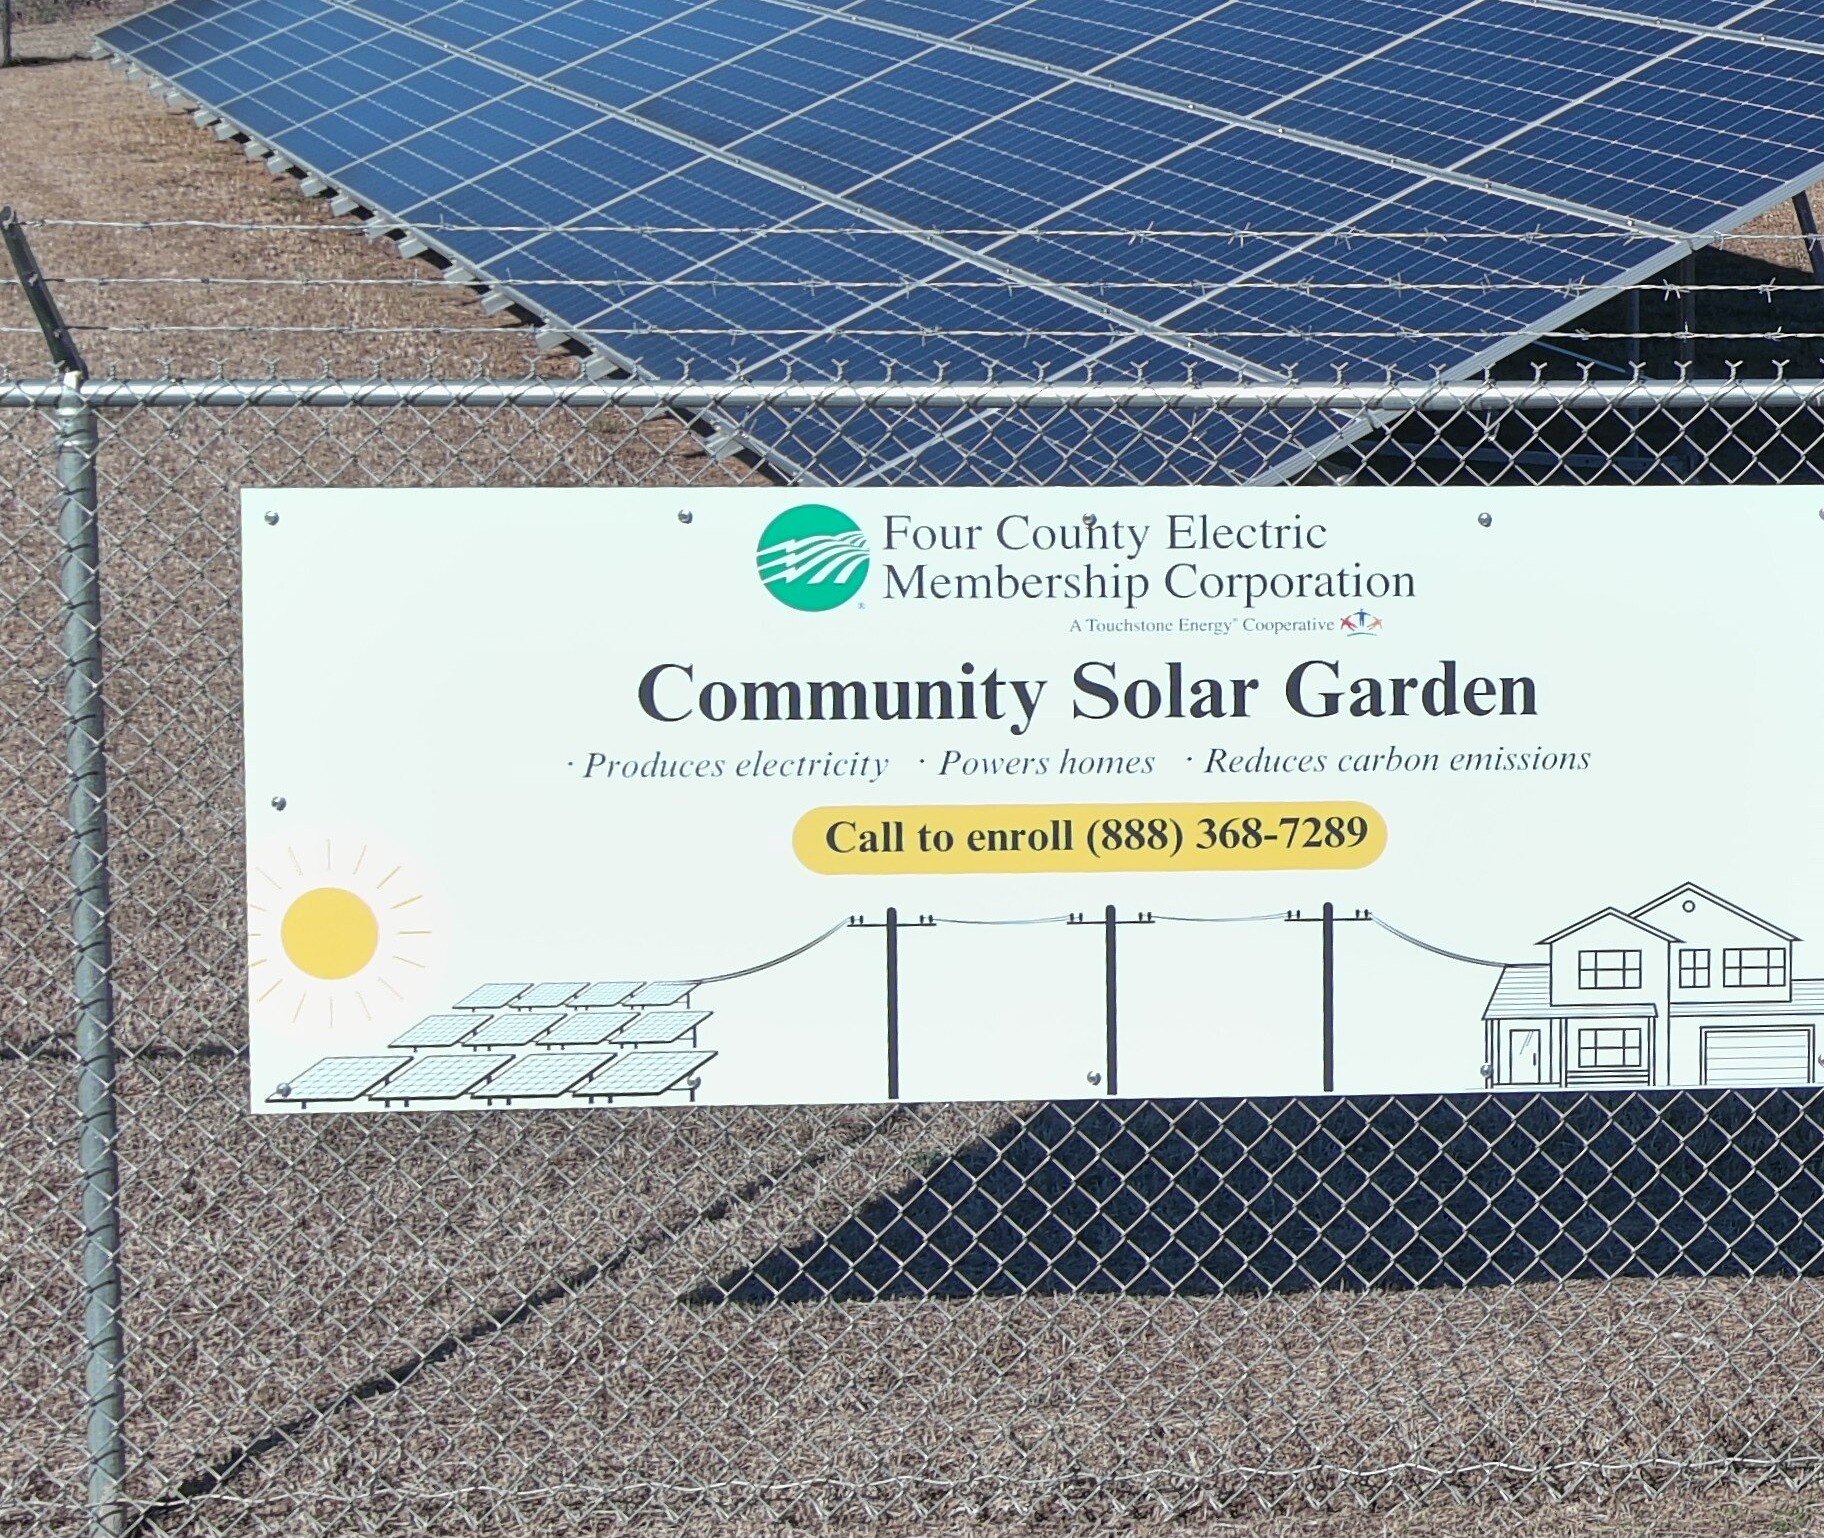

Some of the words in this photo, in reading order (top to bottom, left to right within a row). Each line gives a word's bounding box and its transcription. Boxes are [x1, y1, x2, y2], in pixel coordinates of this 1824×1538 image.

[884, 515, 983, 551] Four
[996, 514, 1150, 560] County
[1166, 513, 1327, 550] Electric
[883, 563, 1149, 609] Membership
[1164, 562, 1415, 608] Corporation
[1069, 619, 1082, 633] A
[1085, 618, 1173, 632] Touchstone
[1242, 617, 1335, 635] Cooperative
[637, 661, 1048, 736] Community
[1072, 661, 1260, 720] Solar
[1285, 659, 1538, 718] Garden
[583, 750, 726, 778] Produces
[735, 749, 890, 783] electricity
[938, 749, 1050, 776] Powers
[1059, 748, 1156, 775] homes
[1204, 746, 1328, 774] Reduces
[1337, 745, 1439, 773] carbon
[1449, 745, 1592, 772] emissions
[825, 820, 904, 854] Call
[917, 823, 954, 852] to
[967, 819, 1073, 852] enroll
[1086, 818, 1183, 858] (888)
[1195, 816, 1369, 850] 368-7289
